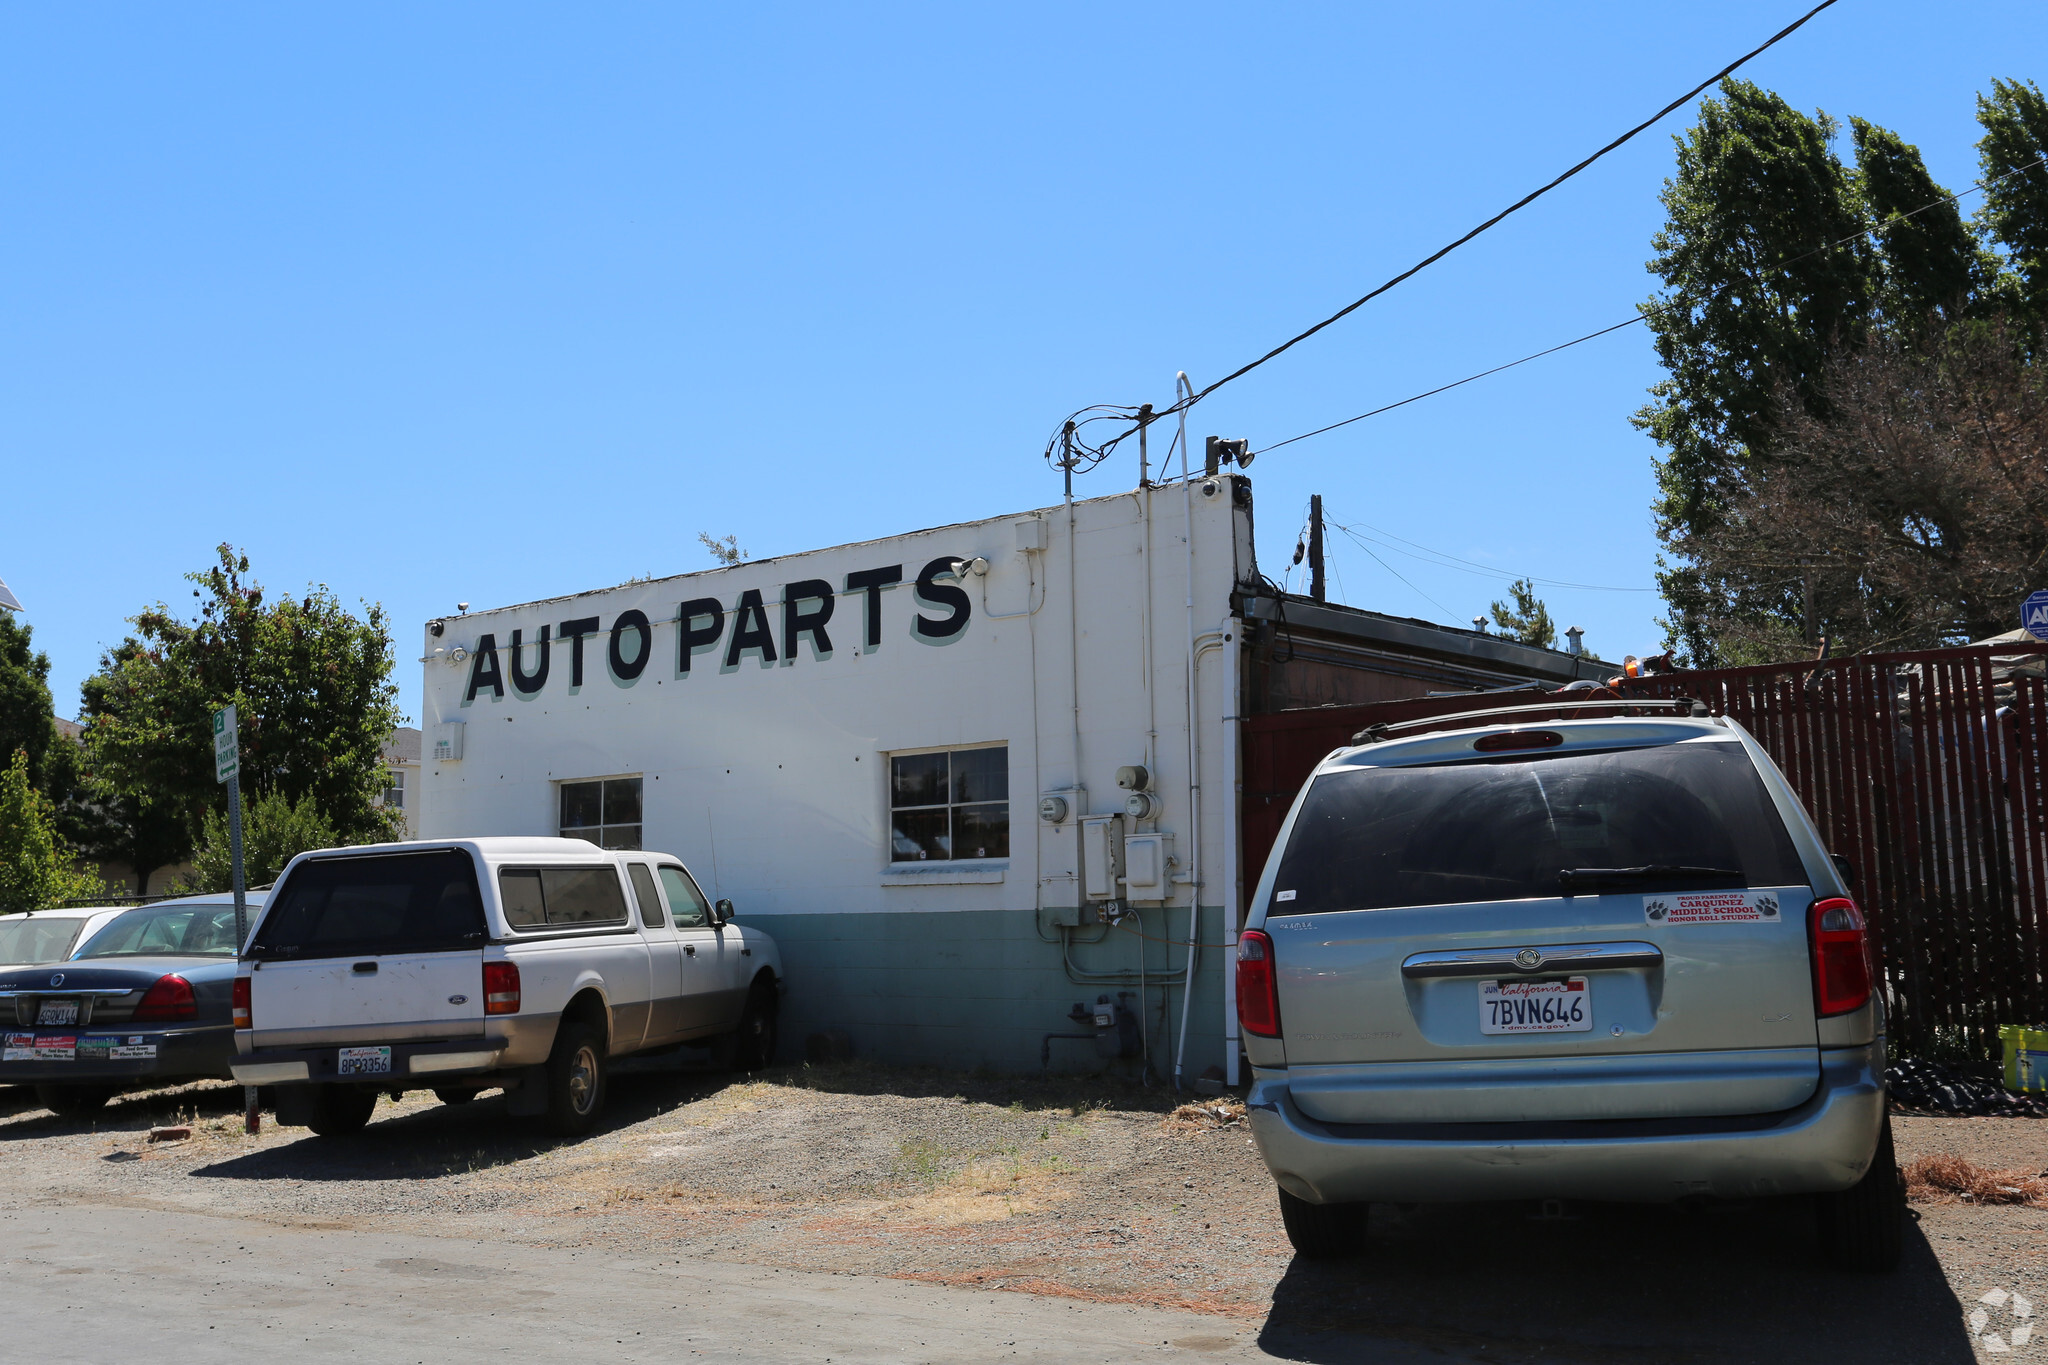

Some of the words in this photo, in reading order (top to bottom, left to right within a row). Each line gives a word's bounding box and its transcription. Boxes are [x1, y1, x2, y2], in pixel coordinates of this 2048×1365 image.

[464, 609, 652, 703] AUTO
[677, 556, 972, 676] PARTS
[216, 714, 222, 730] 2
[219, 731, 233, 749] HOUR
[217, 746, 237, 767] PARKING
[1670, 908, 1711, 916] MIDDLE
[1713, 906, 1756, 914] SCHOOL
[1679, 899, 1744, 908] CARQUINEZ
[1668, 915, 1696, 923] HONOR
[1698, 914, 1720, 922] ROLL
[1484, 986, 1498, 994] JUN
[1501, 984, 1567, 998] California
[1486, 997, 1583, 1026] 7BVN646
[349, 1048, 382, 1058] California
